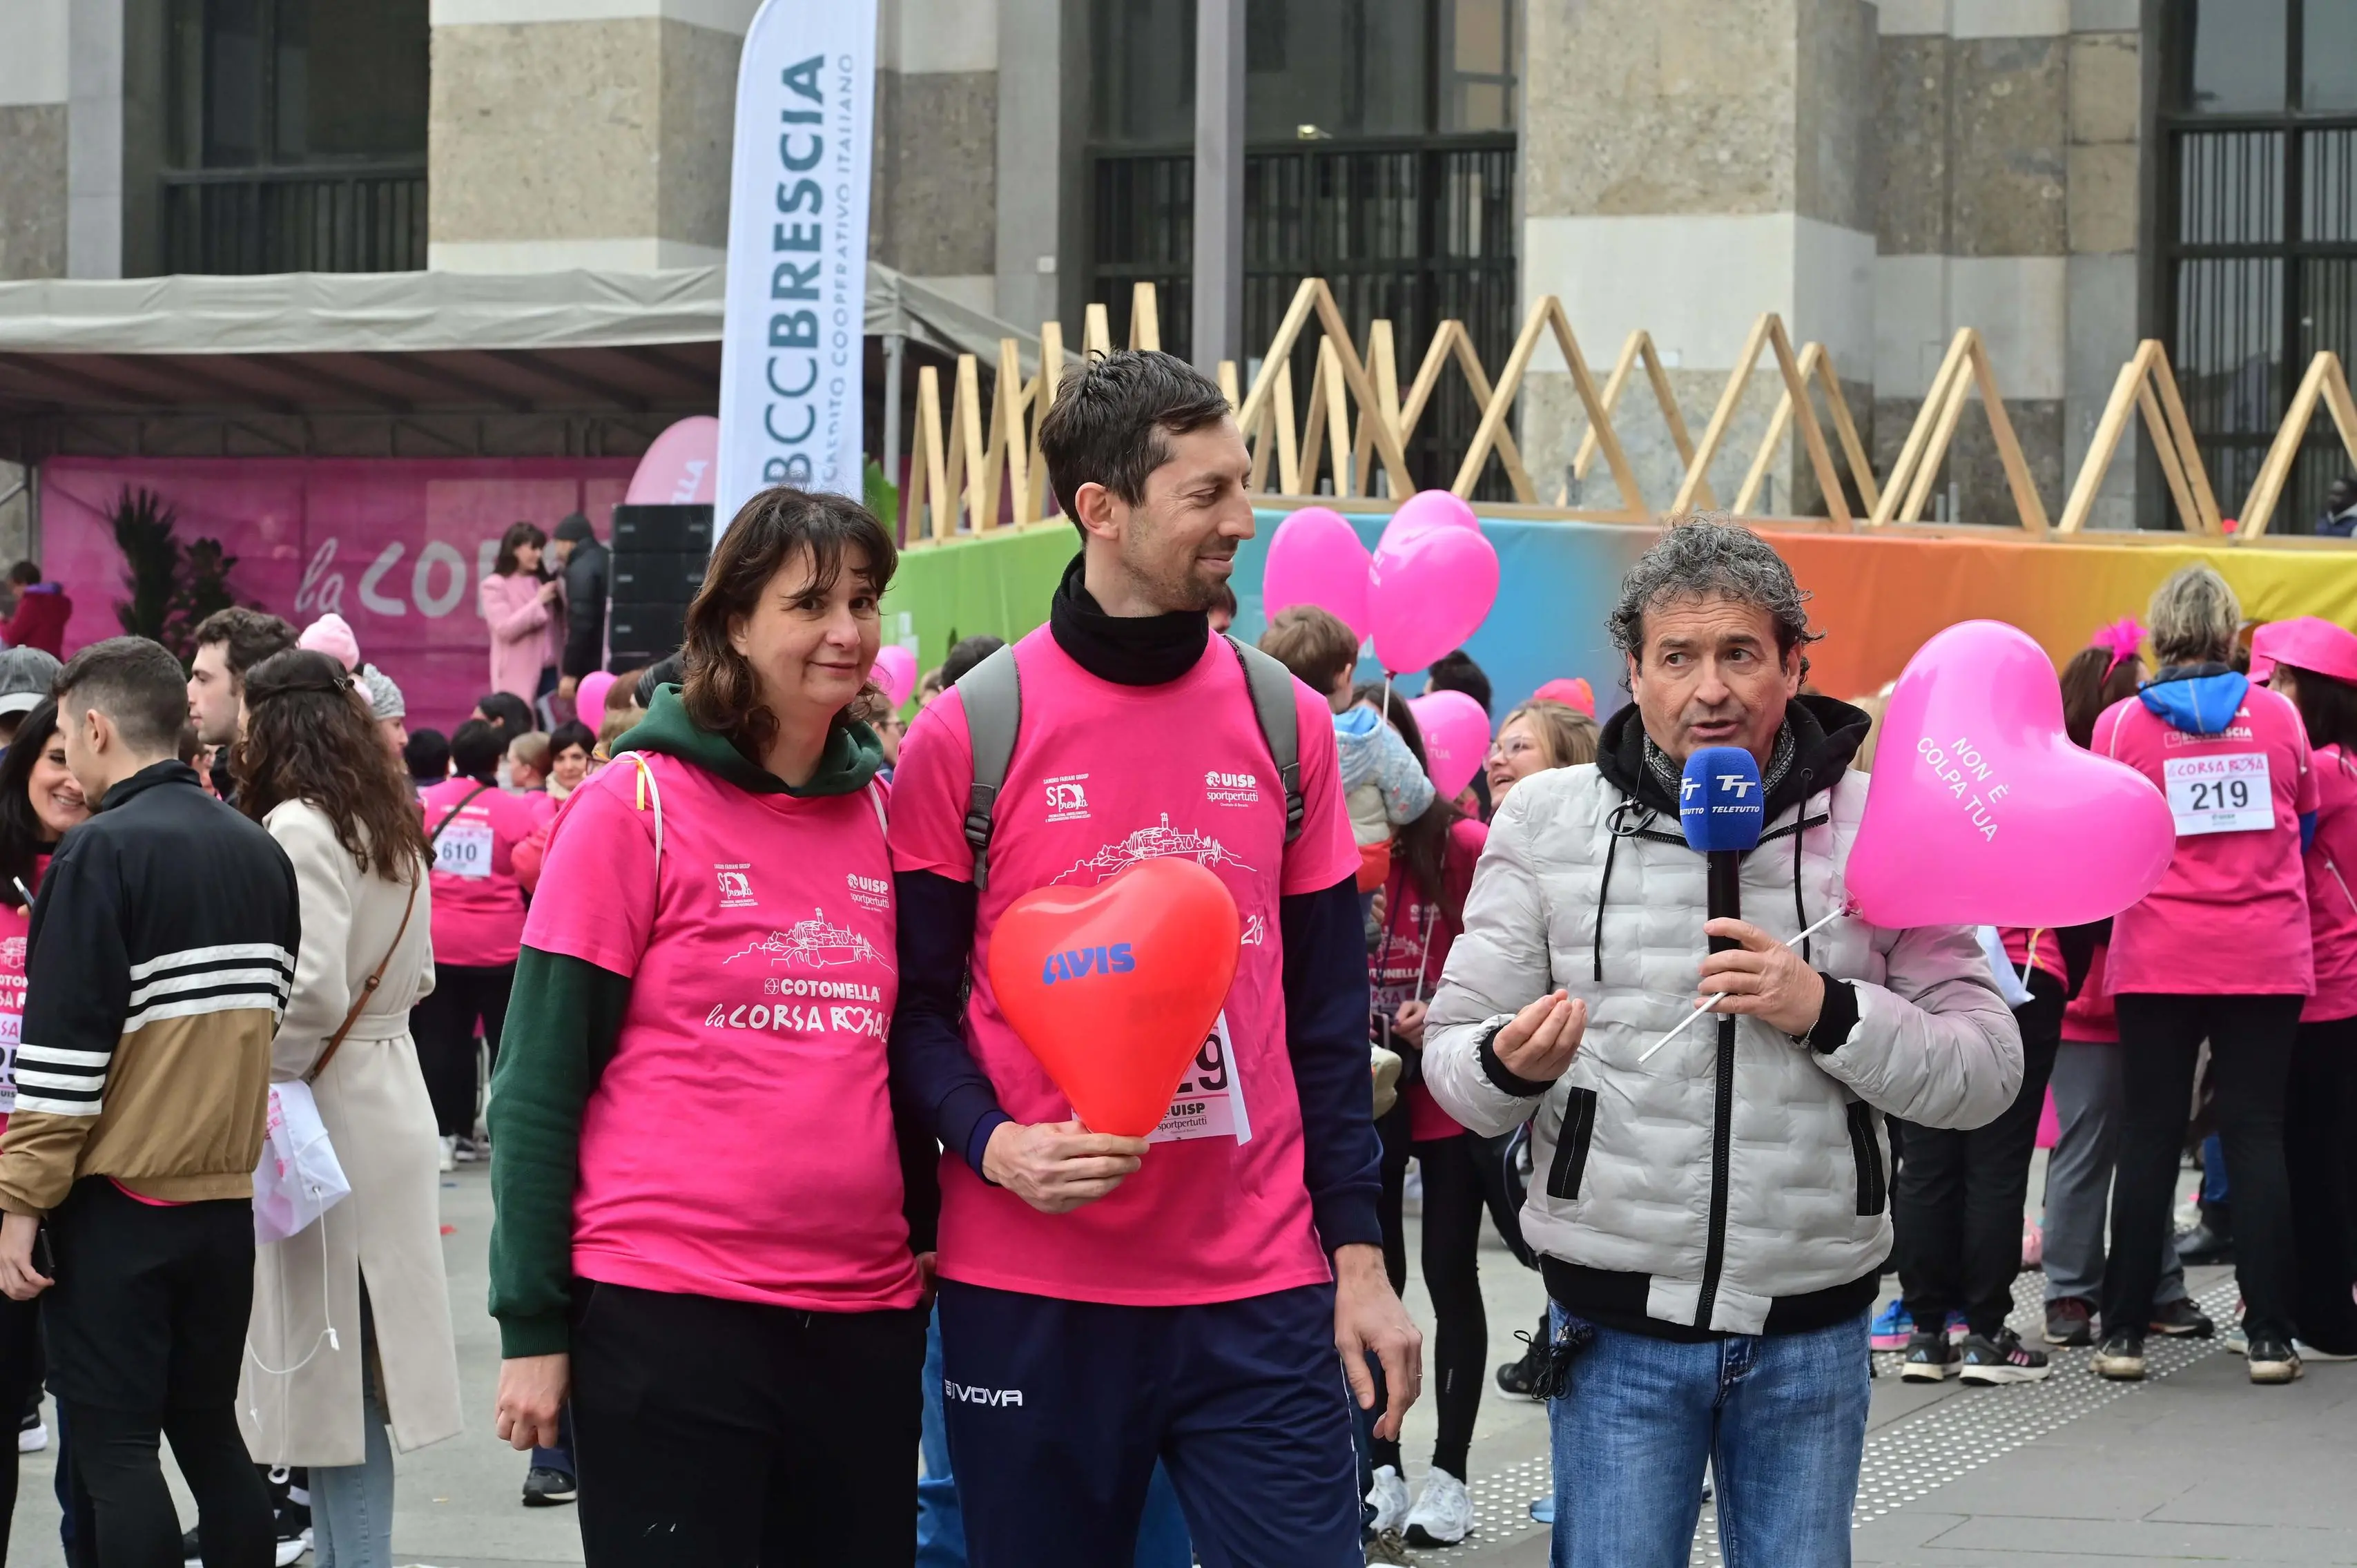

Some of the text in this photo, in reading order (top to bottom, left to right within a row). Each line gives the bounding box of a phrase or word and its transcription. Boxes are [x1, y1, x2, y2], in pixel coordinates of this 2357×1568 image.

[762, 54, 824, 483] BCCBRESCIA
[1951, 737, 2009, 804] NON È
[2177, 760, 2225, 776] CORSA
[1221, 773, 1256, 788] UISP
[1917, 737, 1998, 842] COLPA TUA
[1206, 791, 1259, 803] sportpertutti
[2190, 780, 2249, 811] 219
[442, 841, 477, 862] 610
[859, 876, 889, 894] UISP
[850, 893, 890, 909] sportpertutti
[1042, 943, 1136, 985] AVIS
[780, 978, 880, 1003] COTONELLA
[705, 1003, 725, 1028] la
[729, 1005, 825, 1032] CORSA
[1171, 1102, 1205, 1116] UISP
[1158, 1116, 1207, 1132] sportpertutti
[944, 1379, 1022, 1407] GIVOVA
